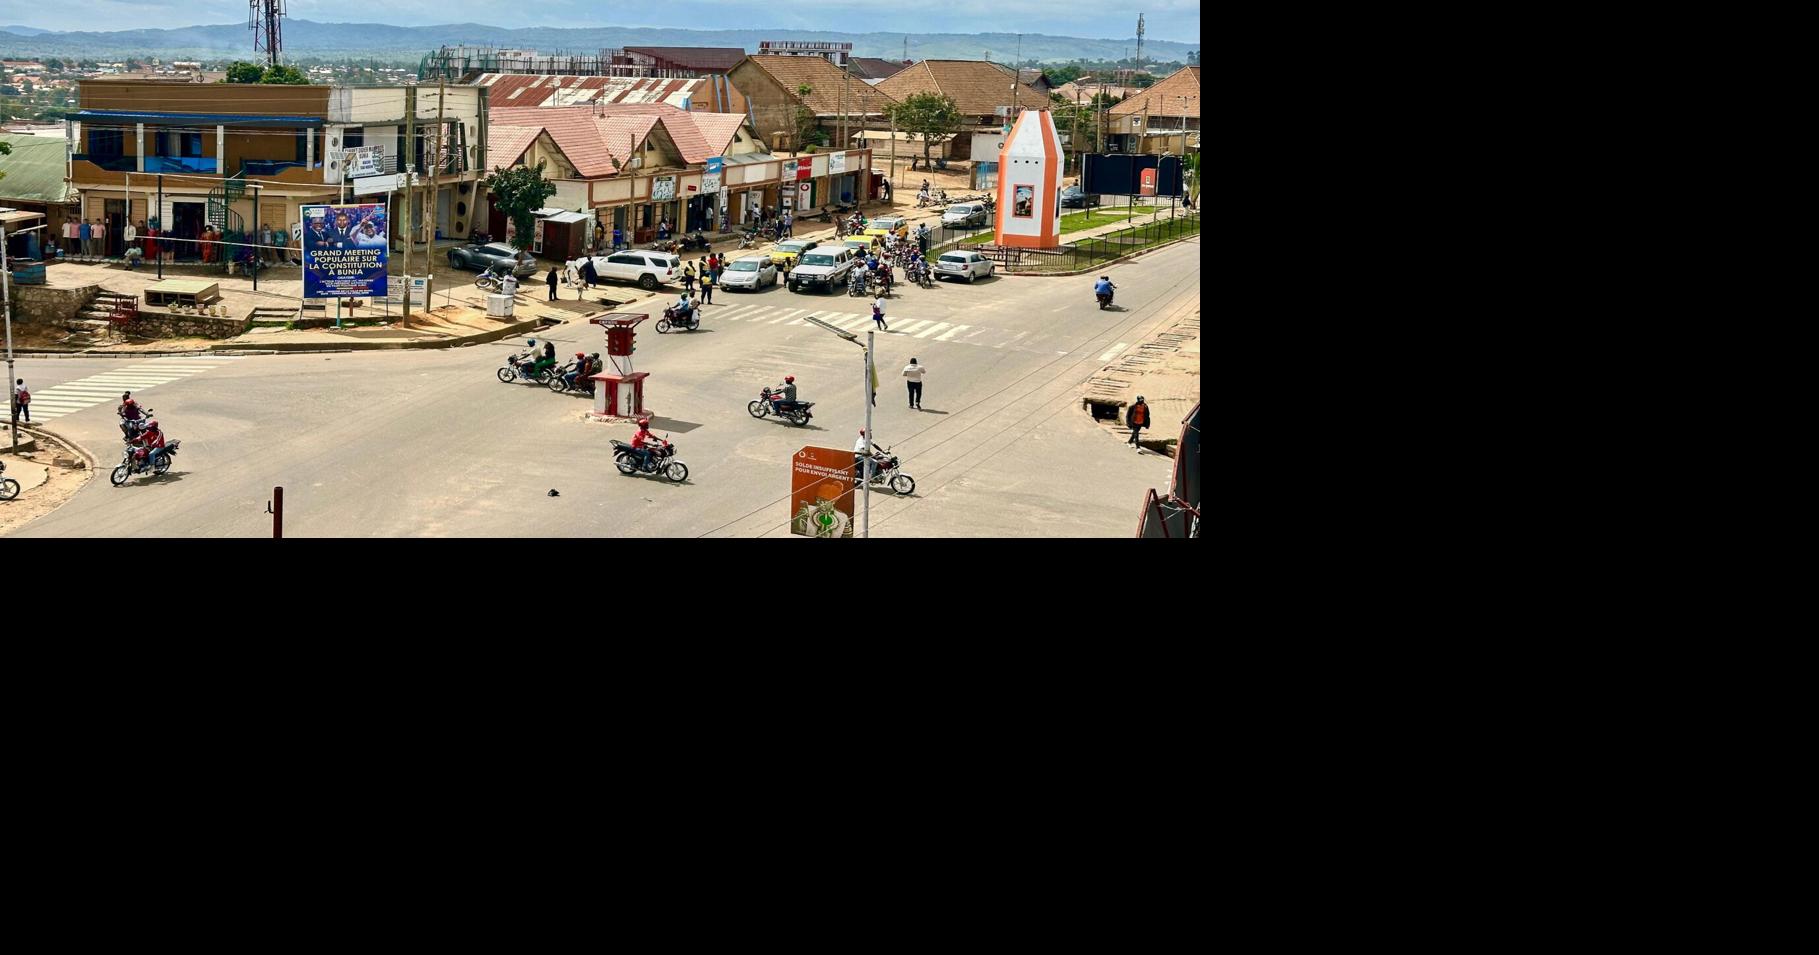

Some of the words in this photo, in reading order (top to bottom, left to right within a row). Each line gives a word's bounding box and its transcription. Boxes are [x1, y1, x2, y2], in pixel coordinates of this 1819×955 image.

[795, 461, 813, 469] SOLDE
[813, 464, 849, 476] INSUFFISANT
[810, 469, 827, 478] ENVOI
[827, 472, 850, 482] ARGENT
